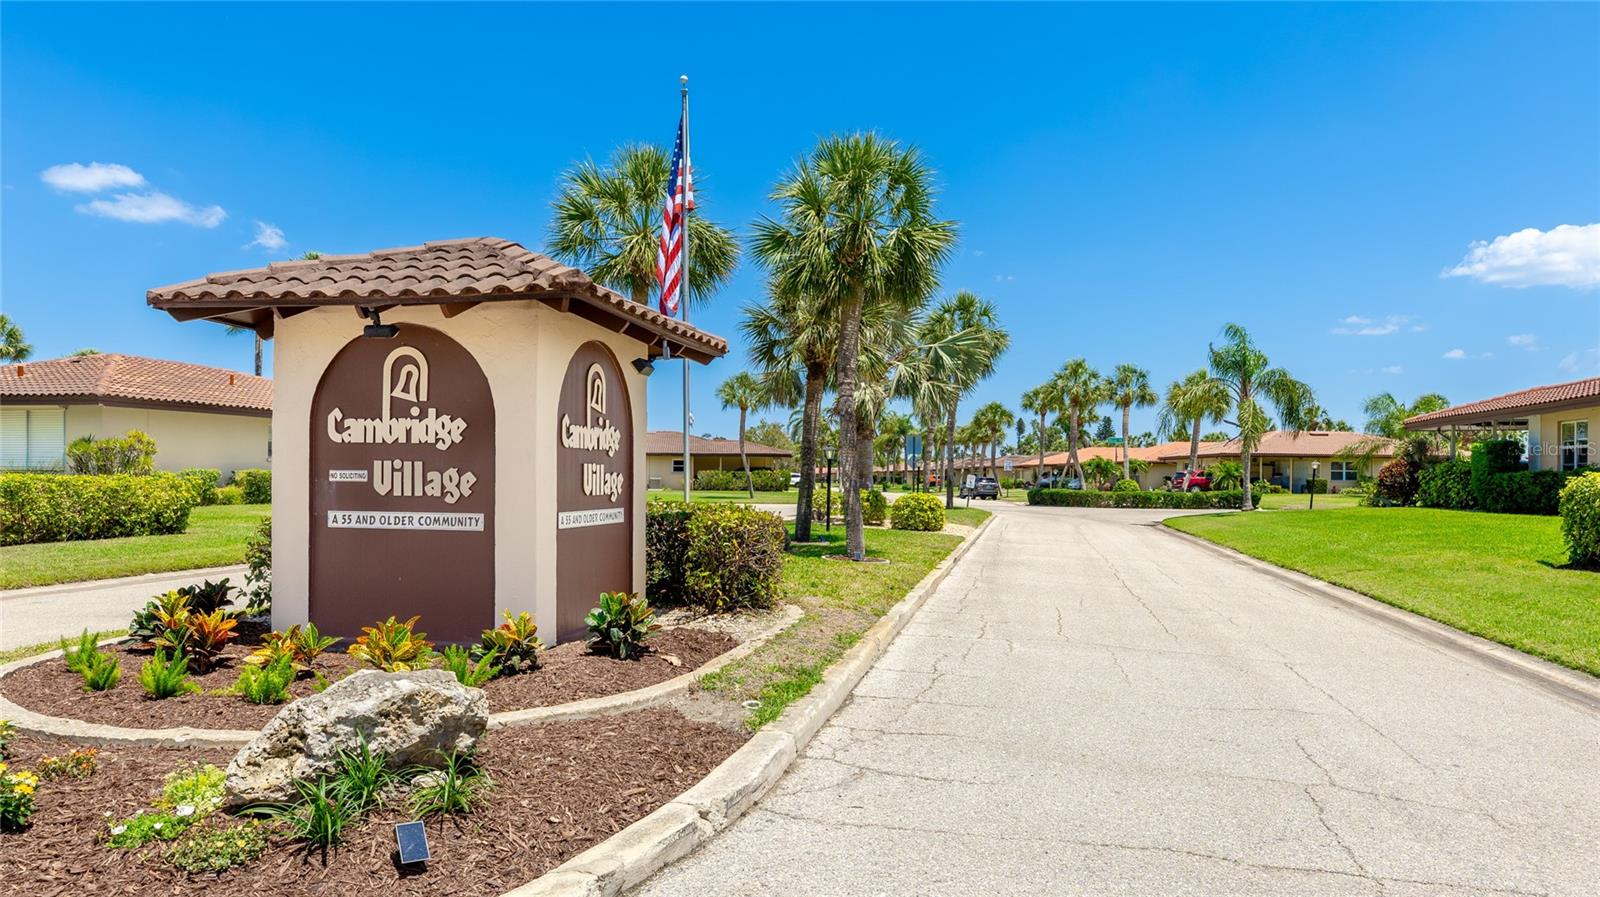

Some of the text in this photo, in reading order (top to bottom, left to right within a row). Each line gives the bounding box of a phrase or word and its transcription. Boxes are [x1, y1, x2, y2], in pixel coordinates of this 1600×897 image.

[327, 406, 468, 451] Cambridge
[561, 413, 621, 458] Cambridge
[339, 472, 367, 480] SOLICITING
[373, 458, 478, 504] Village
[583, 462, 624, 503] Village
[331, 514, 480, 528] A 55 AND OLDER COMMUNITY
[565, 514, 572, 525] 55
[572, 514, 582, 525] AND
[582, 513, 599, 524] OLDER
